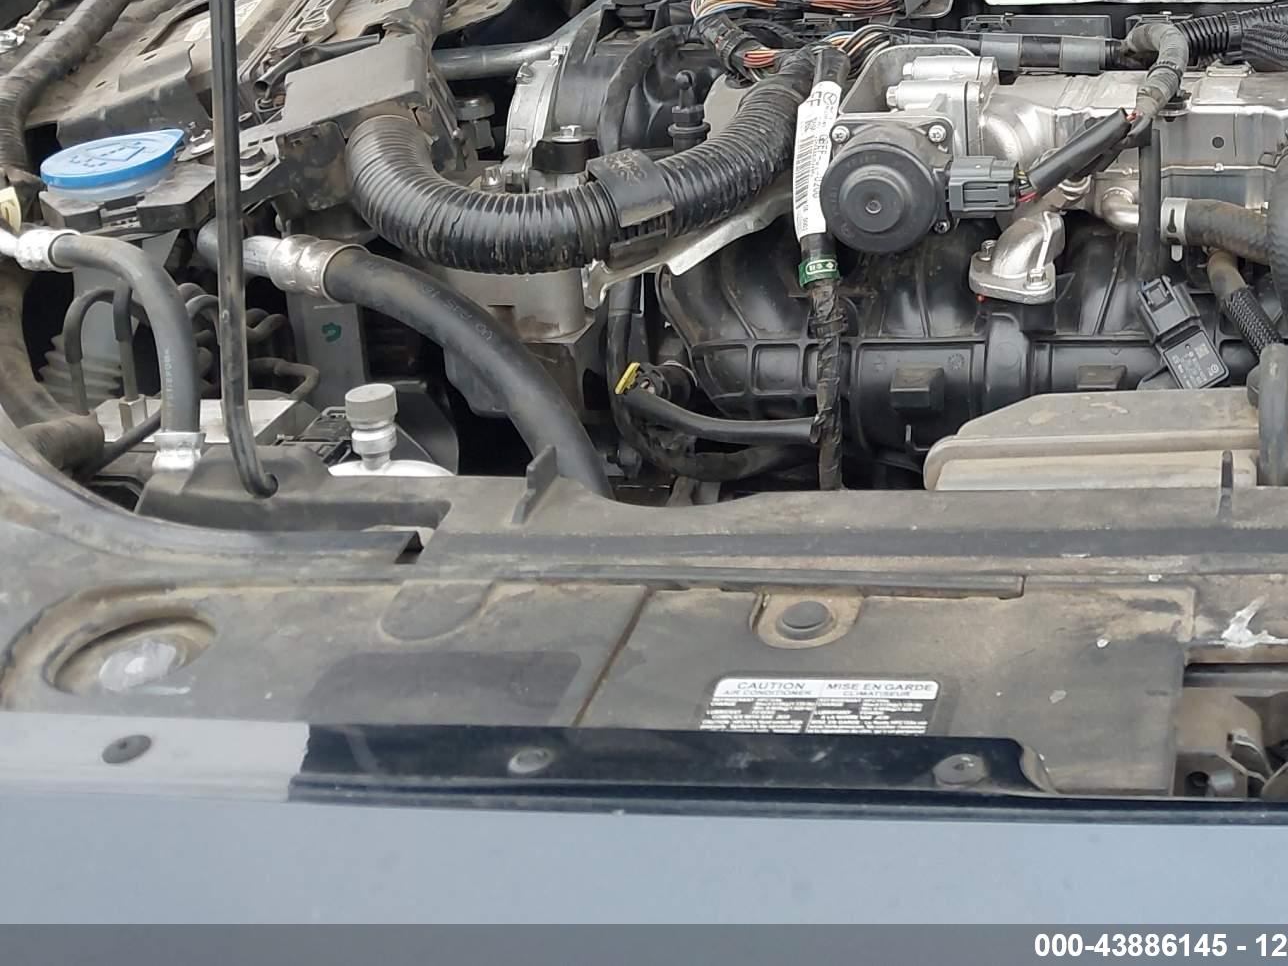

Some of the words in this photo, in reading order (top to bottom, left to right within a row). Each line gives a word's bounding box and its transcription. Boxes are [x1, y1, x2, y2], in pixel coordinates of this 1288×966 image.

[736, 681, 806, 690] CAUTION
[826, 682, 859, 690] MISE
[863, 683, 882, 691] EN
[884, 683, 934, 691] GARDE
